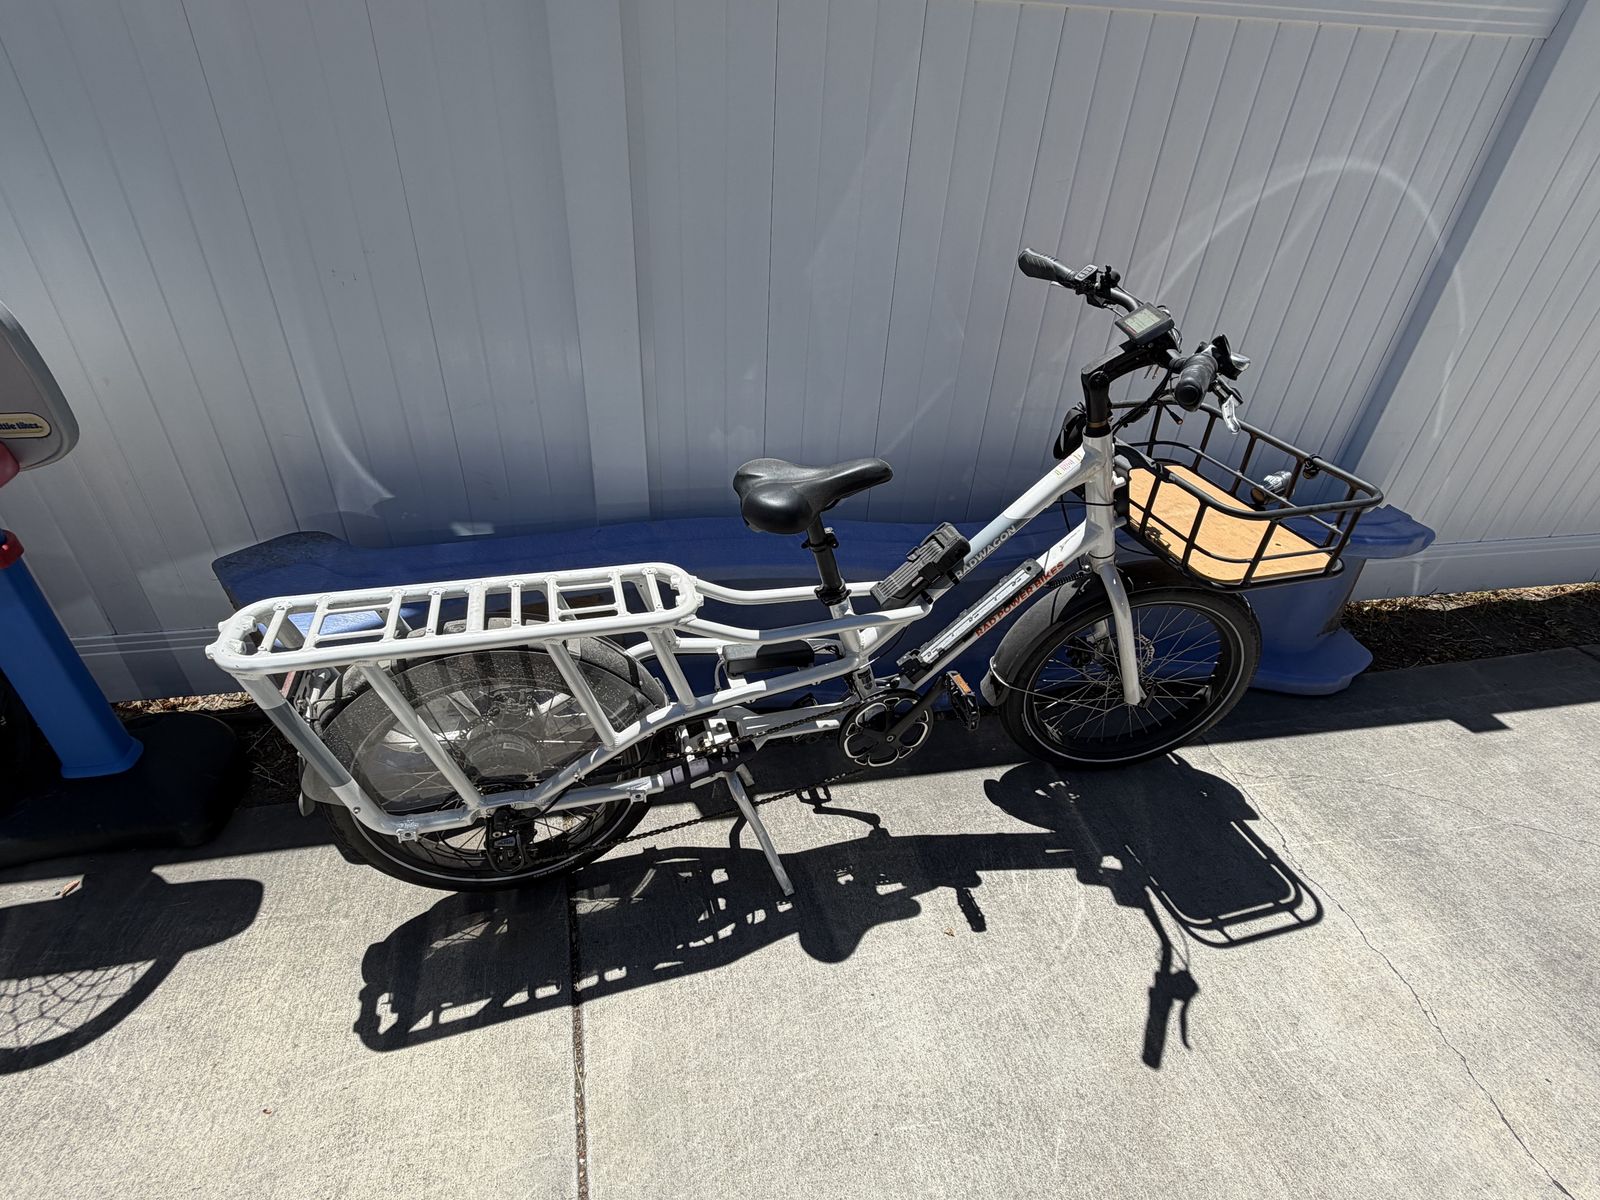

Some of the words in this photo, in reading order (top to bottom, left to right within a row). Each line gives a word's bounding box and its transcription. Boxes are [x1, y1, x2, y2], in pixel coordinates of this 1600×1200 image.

[954, 525, 1017, 580] RADWAGON
[975, 617, 997, 637] RAD
[996, 585, 1034, 620] POWER
[1034, 561, 1065, 589] BIKES
